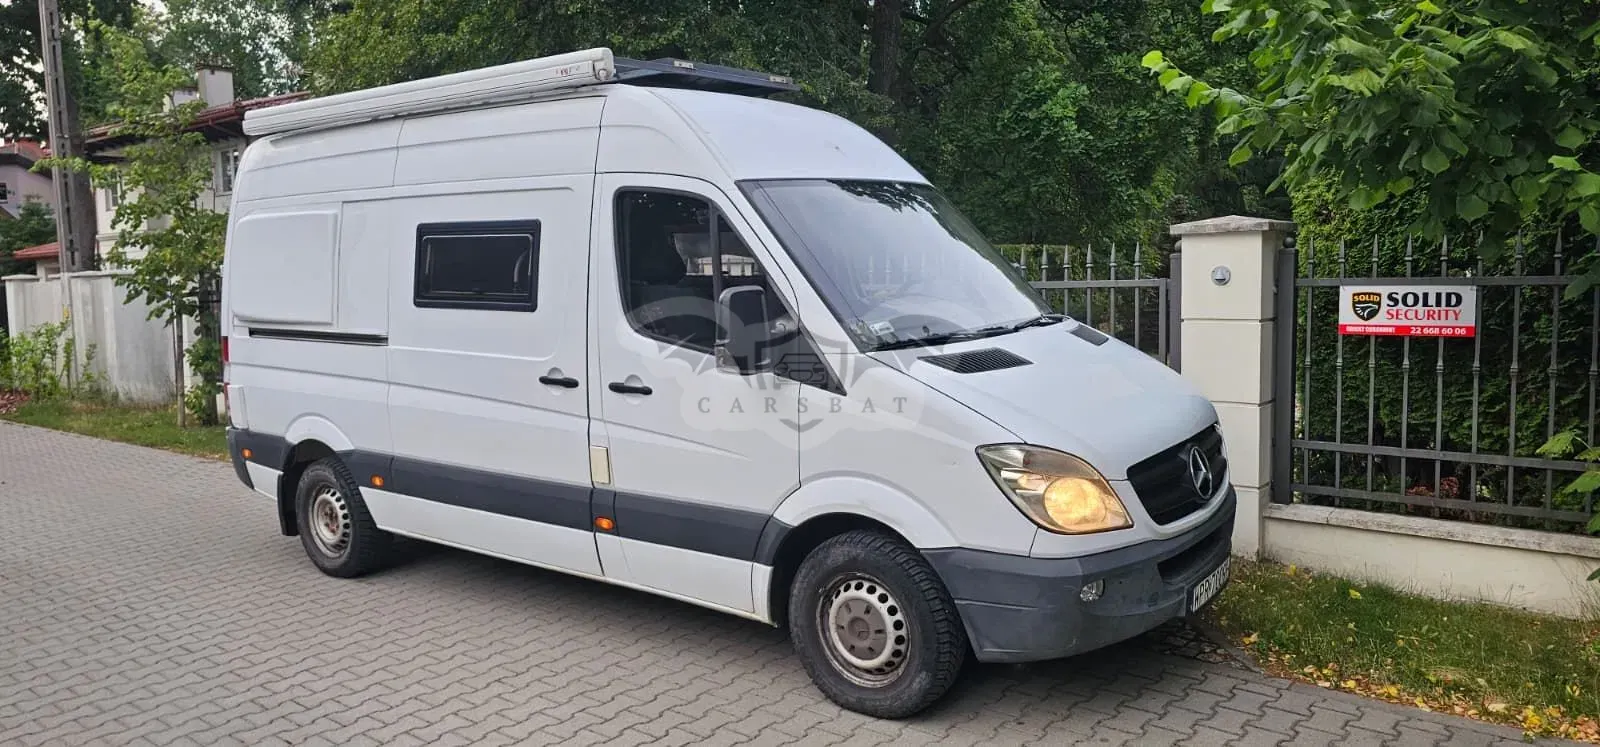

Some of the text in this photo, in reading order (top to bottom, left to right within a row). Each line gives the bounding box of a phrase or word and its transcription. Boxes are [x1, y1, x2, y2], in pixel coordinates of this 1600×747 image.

[1353, 294, 1380, 302] SOLID
[1386, 291, 1463, 308] SOLID
[1386, 309, 1462, 321] SECURITY
[1410, 326, 1422, 334] 22
[1441, 327, 1453, 335] 60
[1454, 327, 1467, 335] 06
